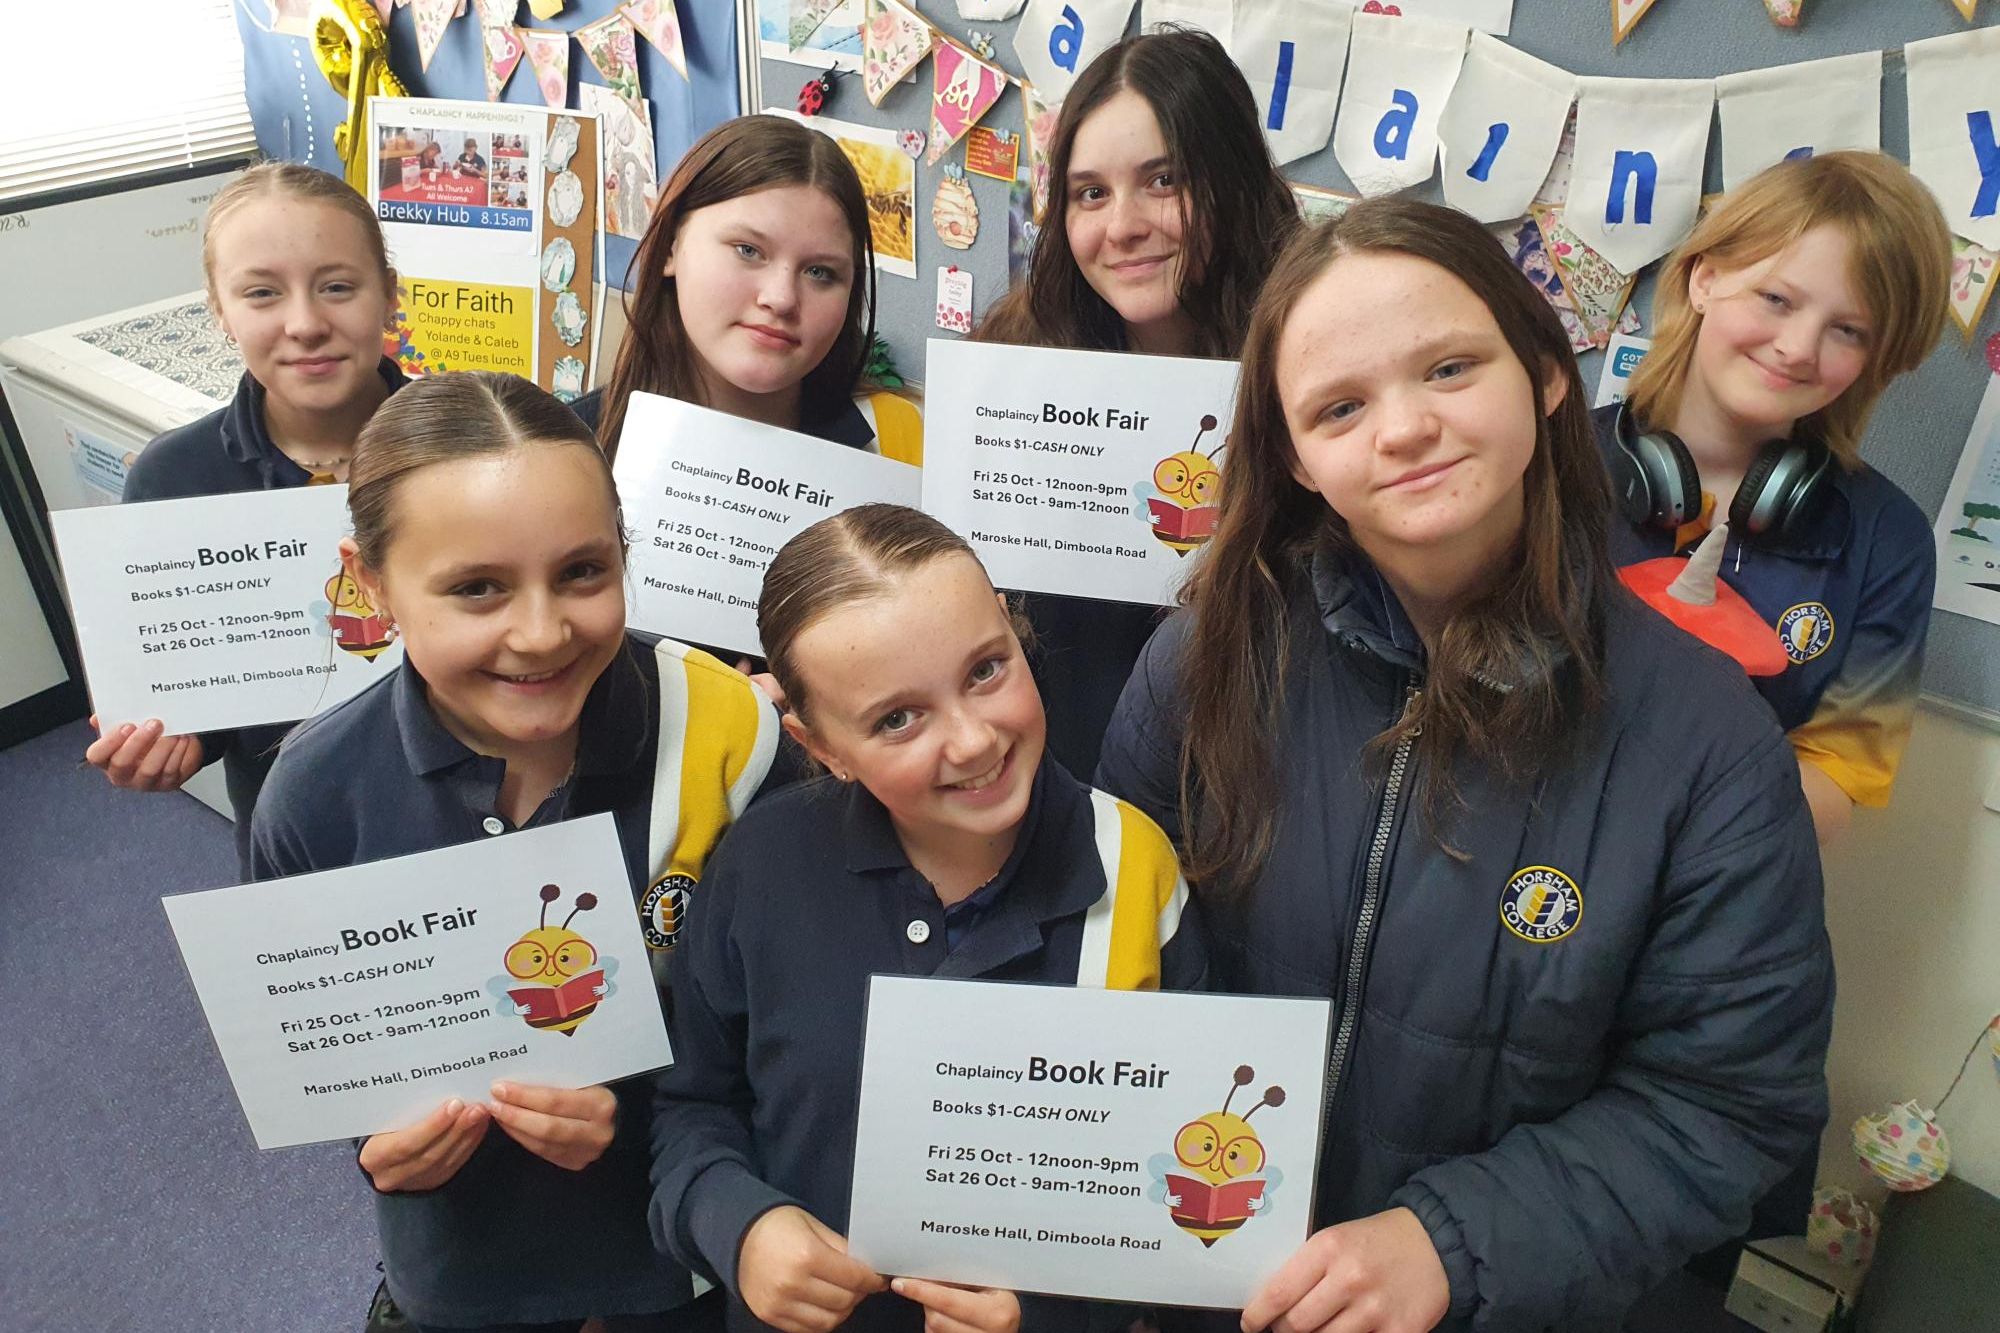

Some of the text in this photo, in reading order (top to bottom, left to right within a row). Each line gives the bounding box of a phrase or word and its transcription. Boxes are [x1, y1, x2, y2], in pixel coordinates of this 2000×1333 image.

[426, 192, 468, 202] All Welcome
[379, 202, 529, 228] Brekky Hub 8.15am
[412, 284, 513, 314] For Faith
[418, 312, 496, 329] Chappy chats
[426, 330, 519, 349] Yolande & Caleb
[430, 348, 525, 366] @ A9 Tues lunch
[976, 403, 1149, 431] Chaplaincy Book Fair
[975, 434, 1104, 456] Books $1-CASH ONLY
[671, 460, 834, 507] Chaplaincy Book Fair
[973, 470, 989, 482] Fri
[993, 472, 1007, 483] 25
[1010, 474, 1033, 486] Oct
[1045, 477, 1126, 496] 12noon-9pm
[665, 486, 790, 523] Books $1-CASH ONLY
[972, 489, 993, 500] Sat
[996, 491, 1011, 502] 26
[1014, 493, 1037, 505] Oct
[1048, 496, 1129, 515] 9am-12noon
[657, 519, 673, 531] Fri
[676, 523, 692, 535] 25
[694, 527, 717, 541] Oct
[971, 530, 1146, 558] Maroske Hall, Dimboola Road
[125, 538, 307, 574] Chaplaincy Book Fair
[653, 536, 674, 549] Sat
[677, 542, 692, 553] 26
[695, 546, 718, 559] Oct
[131, 577, 270, 601] Books $1-CASH ONLY
[643, 576, 694, 595] Maroske
[697, 588, 724, 604] Hall,
[138, 624, 157, 636] Fri
[160, 622, 177, 633] 25
[180, 619, 206, 630] Oct
[218, 610, 304, 626] 12noon-9pm
[142, 642, 166, 653] Sat
[169, 639, 186, 650] 26
[189, 636, 215, 647] Oct
[226, 627, 310, 643] 9am-12noon
[151, 663, 337, 692] Maroske Hall, Dimboola Road
[1511, 871, 1579, 912] HORSHAM
[1504, 901, 1570, 938] COLLEGE
[256, 906, 477, 964] Chaplaincy Book Fair
[267, 956, 434, 995] Books $1-CASH ONLY
[280, 1020, 302, 1033] Fri
[305, 1016, 326, 1029] 25
[329, 1012, 361, 1025] Oct
[374, 989, 480, 1018] 12noon-9pm
[287, 1040, 316, 1052] Sat
[318, 1035, 339, 1048] 26
[342, 1031, 373, 1044] Oct
[385, 1008, 490, 1037] 9am-12noon
[303, 1044, 527, 1095] Maroske Hall, Dimboola Road
[936, 1056, 1169, 1088] Chaplaincy Book Fair
[932, 1099, 1110, 1122] Books $1-CASH ONLY
[928, 1145, 950, 1159] Fri
[955, 1147, 975, 1161] 25
[980, 1149, 1012, 1164] Oct
[1028, 1152, 1138, 1174] 12noon-9pm
[925, 1168, 955, 1183] Sat
[959, 1171, 979, 1185] 26
[984, 1173, 1016, 1187] Oct
[1031, 1176, 1140, 1196] 9am-12noon
[920, 1220, 1160, 1250] Maroske Hall, Dimboola Road
